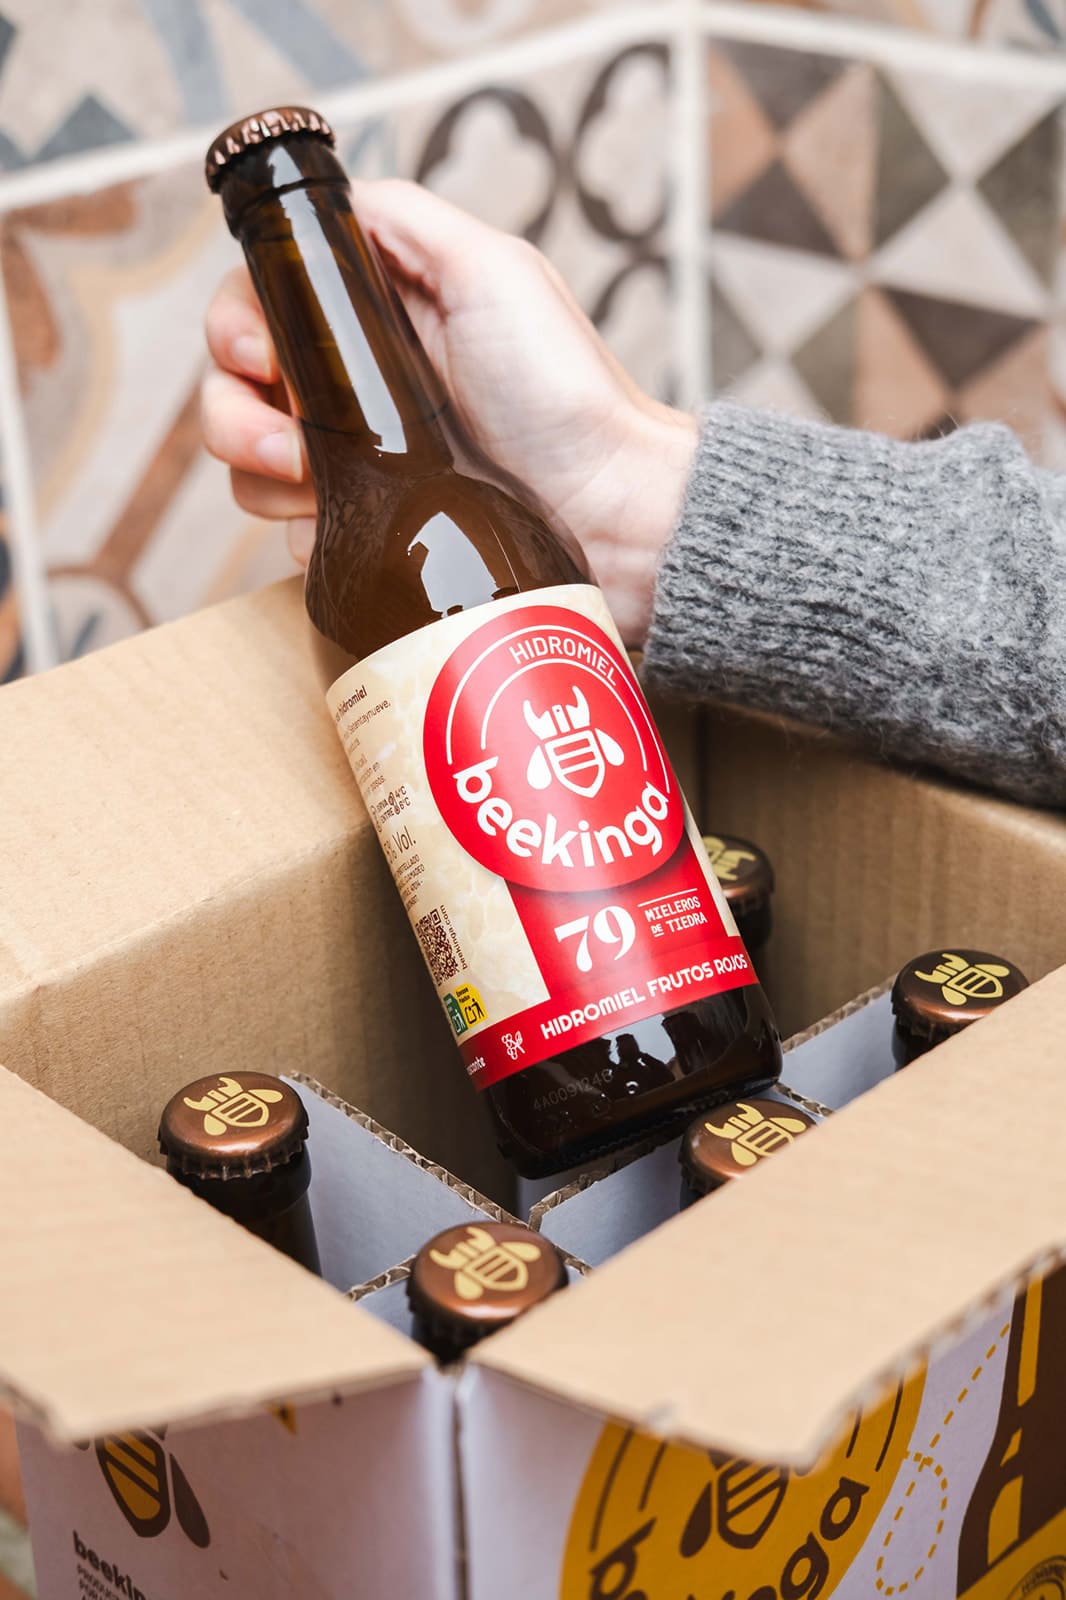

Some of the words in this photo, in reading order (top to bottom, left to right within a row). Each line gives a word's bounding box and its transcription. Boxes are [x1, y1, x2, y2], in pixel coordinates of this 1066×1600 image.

[508, 636, 618, 686] HIDROMIEL
[337, 685, 367, 717] hidromiel
[453, 757, 670, 868] beekinga
[392, 825, 417, 854] Vol.
[645, 896, 702, 922] MIELEROS
[651, 922, 664, 936] DE
[666, 912, 708, 933] TIEDRA
[440, 904, 468, 970] beekinga.com
[554, 904, 637, 972] 79
[540, 987, 646, 1039] HIDROMIEL
[648, 965, 714, 997] FRUTOS
[714, 953, 749, 980] ROJOS
